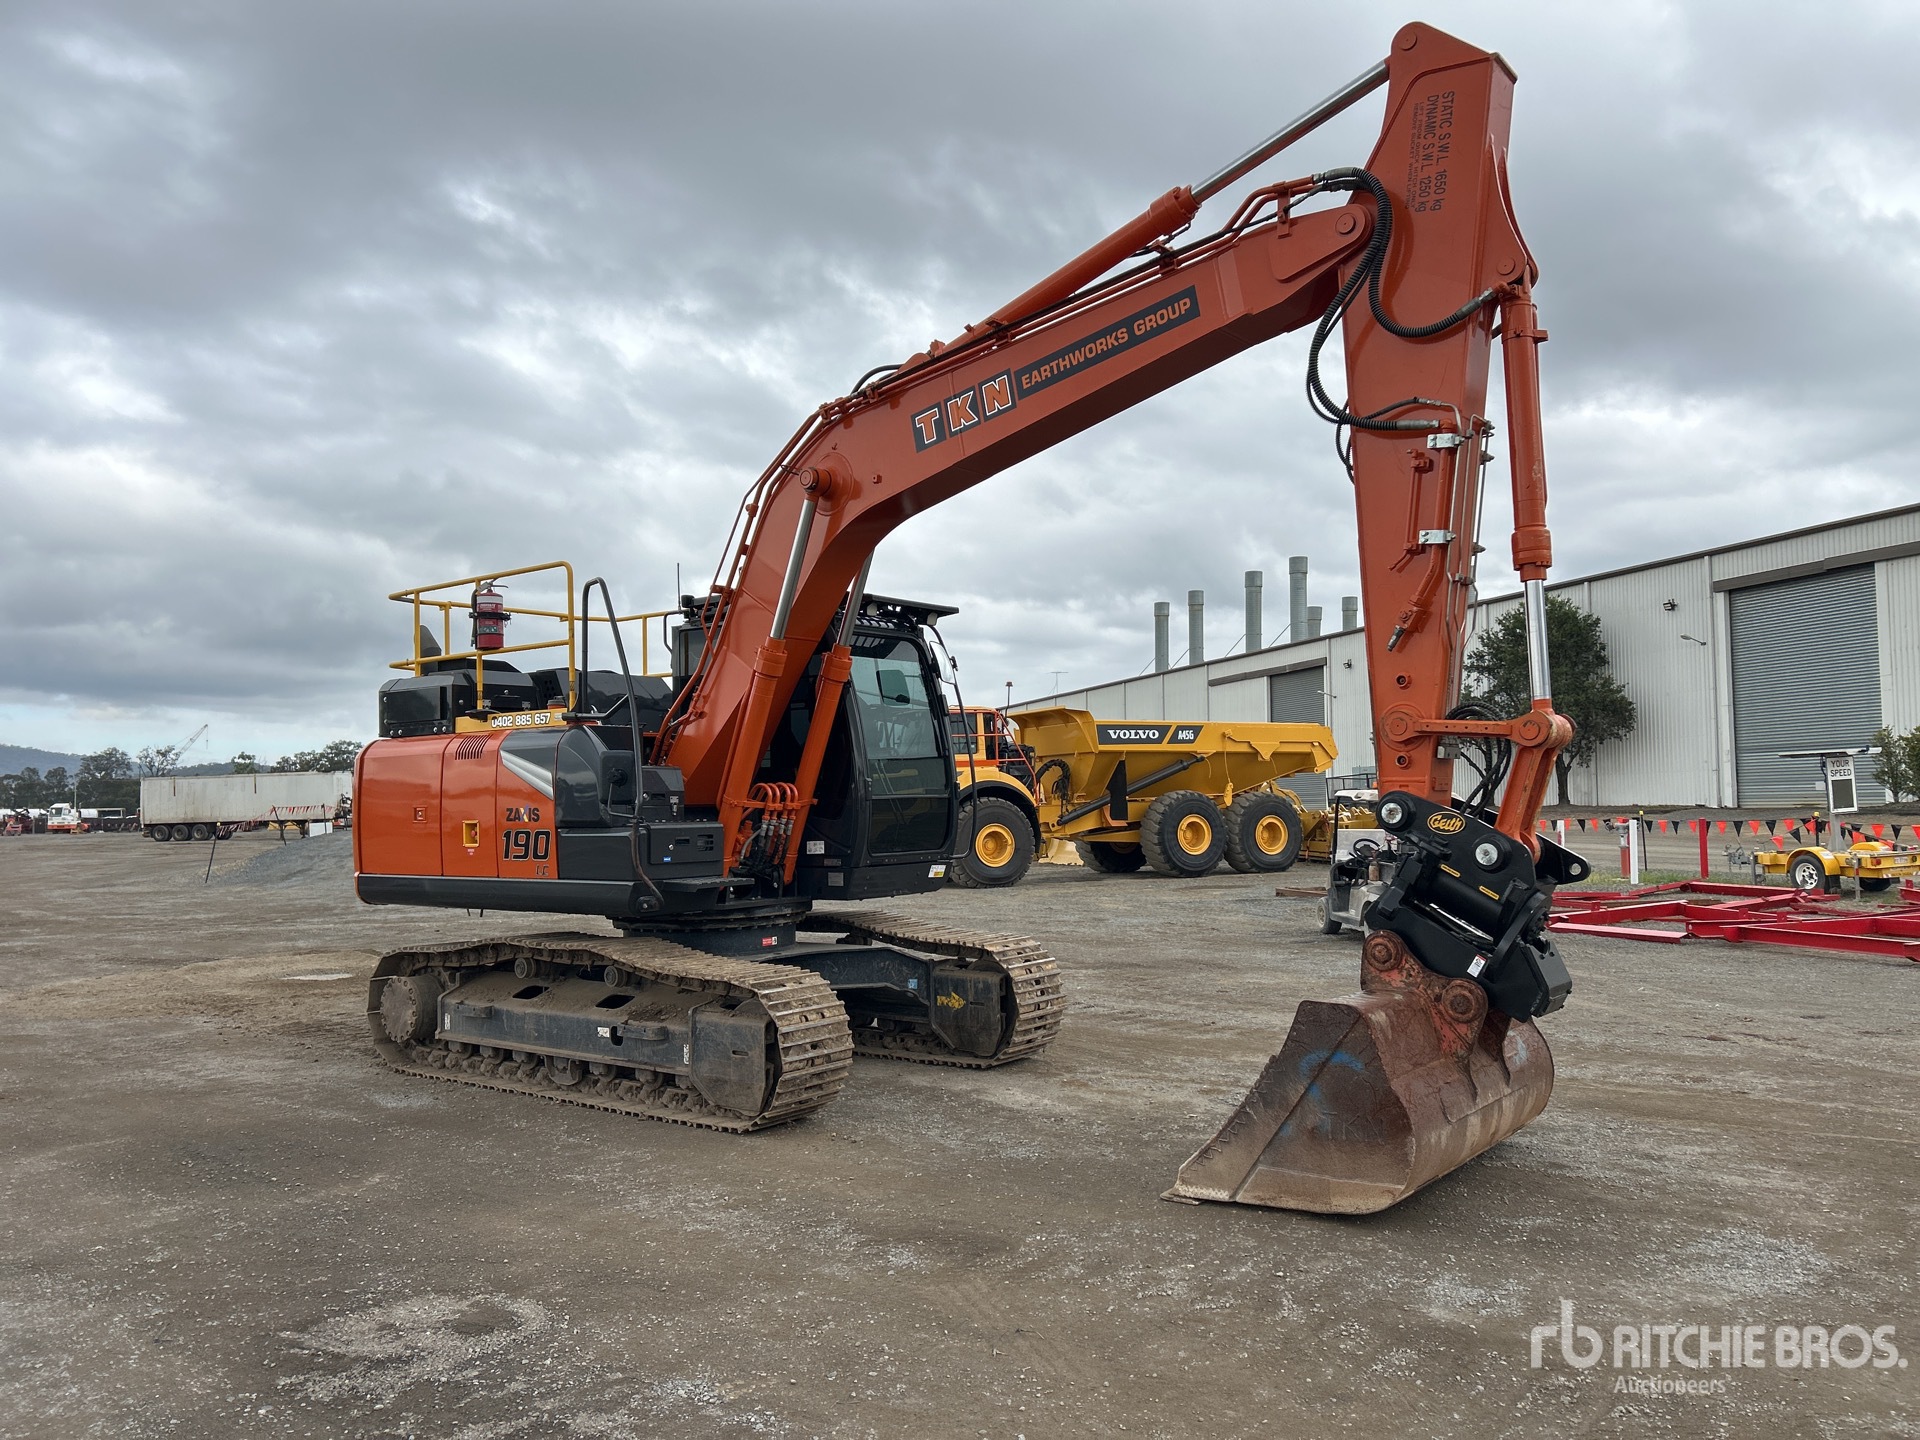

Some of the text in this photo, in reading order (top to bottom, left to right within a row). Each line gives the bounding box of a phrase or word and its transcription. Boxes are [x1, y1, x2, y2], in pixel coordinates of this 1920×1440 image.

[1415, 95, 1440, 212] DYNAMIC S.W.L. 1250 kg
[1430, 91, 1455, 211] STATIC S.W.L. 1650 kg
[915, 297, 1192, 444] TKN EARTHWORKS GROUP
[491, 715, 513, 728] 0402
[515, 713, 532, 726] 885
[534, 712, 551, 724] 657
[1107, 729, 1194, 740] VOLVO A45G
[1830, 760, 1850, 768] YOUR
[1830, 769, 1852, 777] SPEED
[506, 804, 540, 822] ZAXIS
[502, 829, 552, 861] 190
